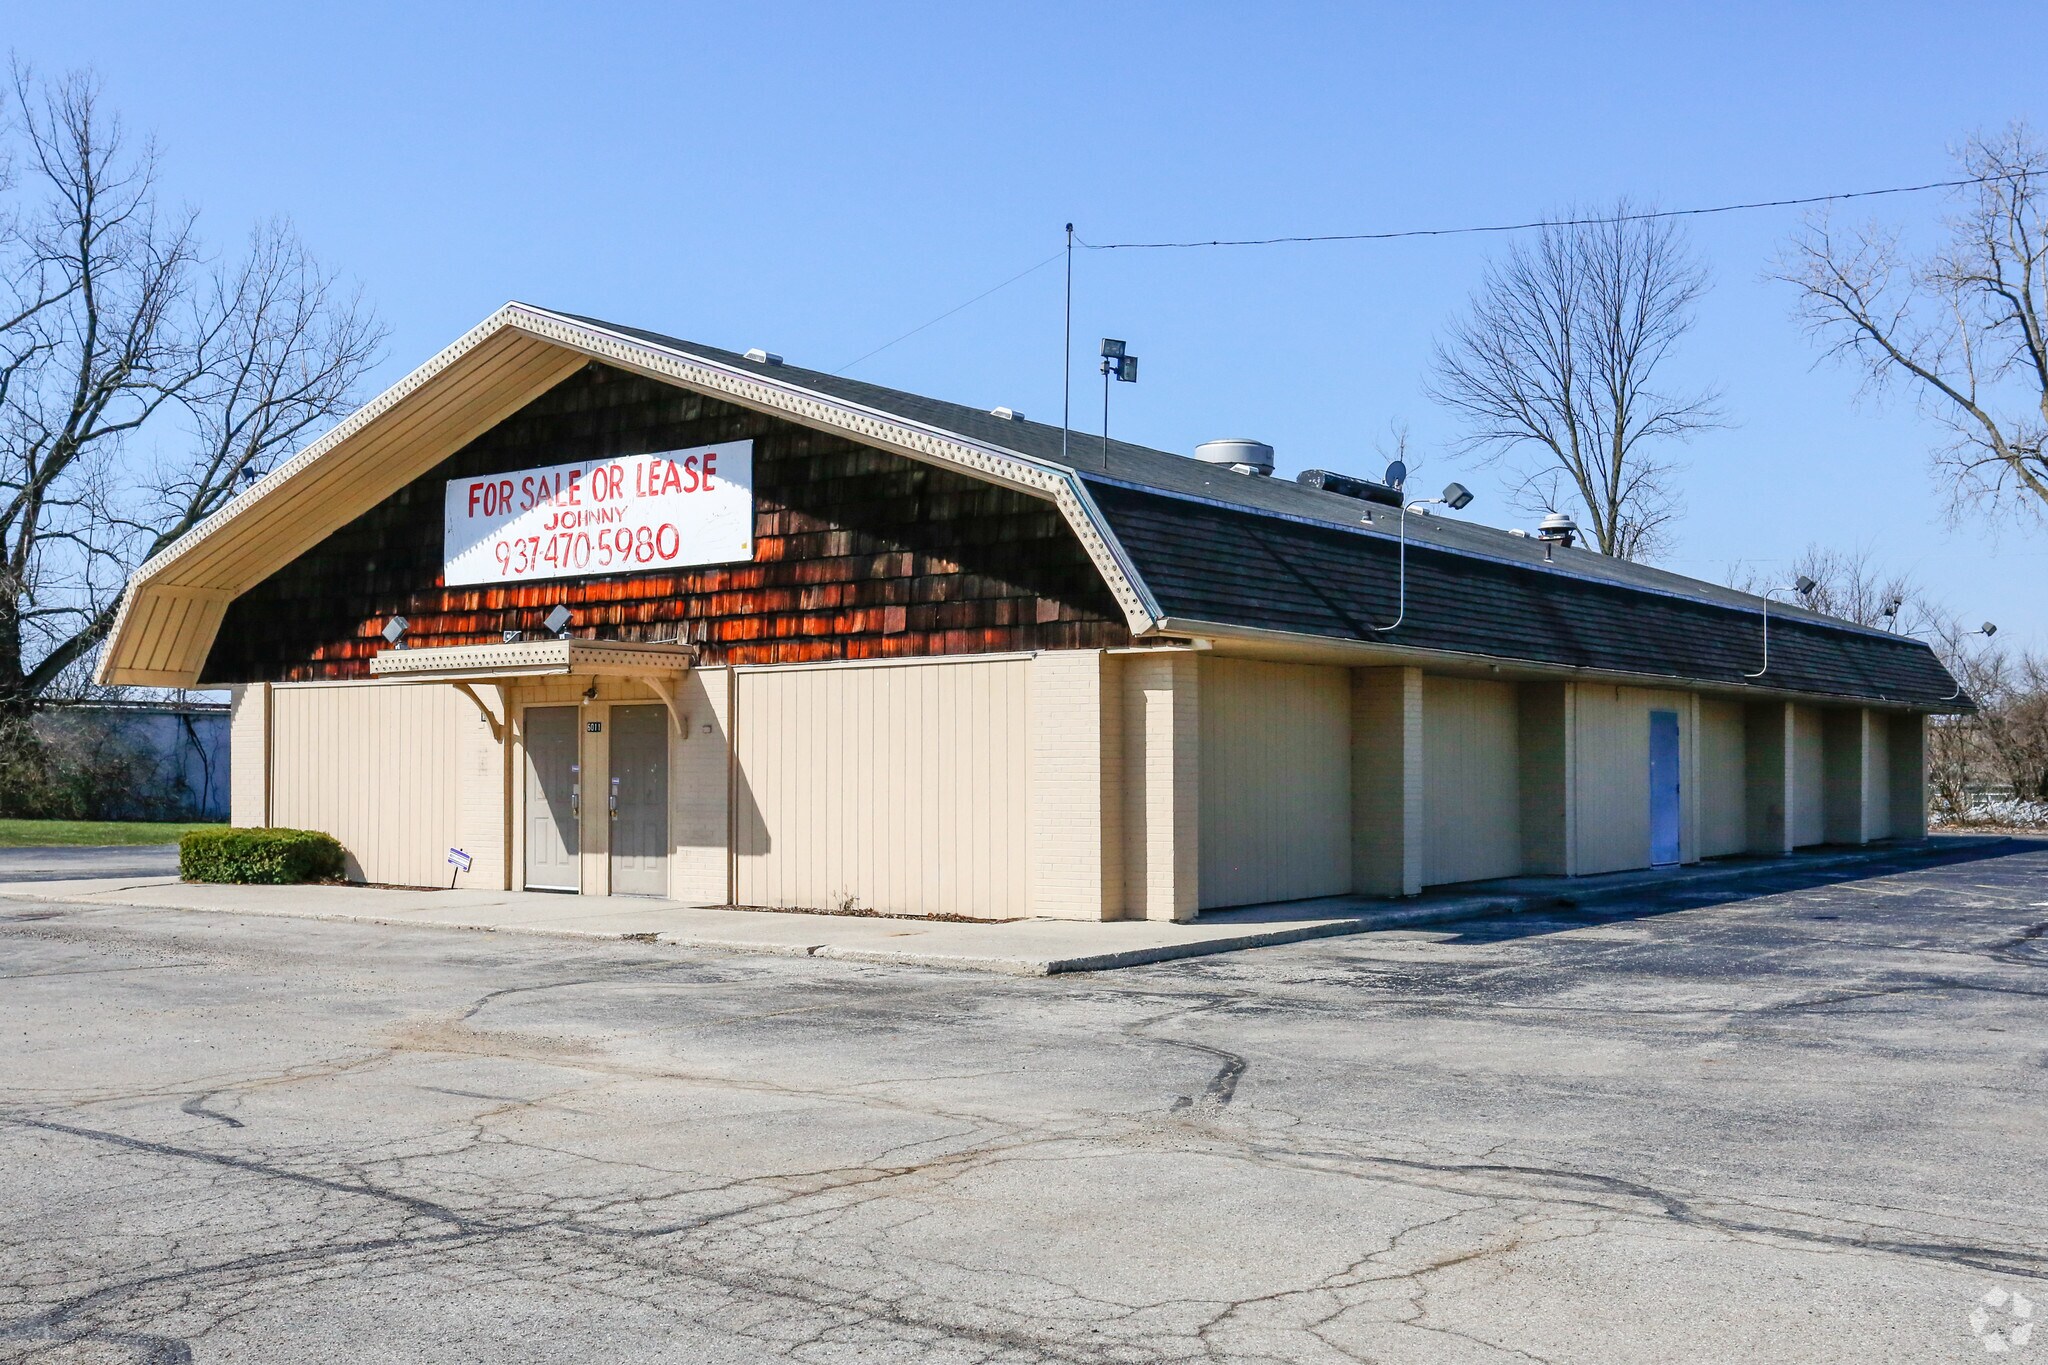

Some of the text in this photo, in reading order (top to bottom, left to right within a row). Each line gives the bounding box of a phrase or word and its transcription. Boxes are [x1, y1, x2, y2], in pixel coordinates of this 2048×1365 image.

[468, 453, 717, 518] FOR SALE OR LEASE
[544, 505, 629, 531] JOHNNY
